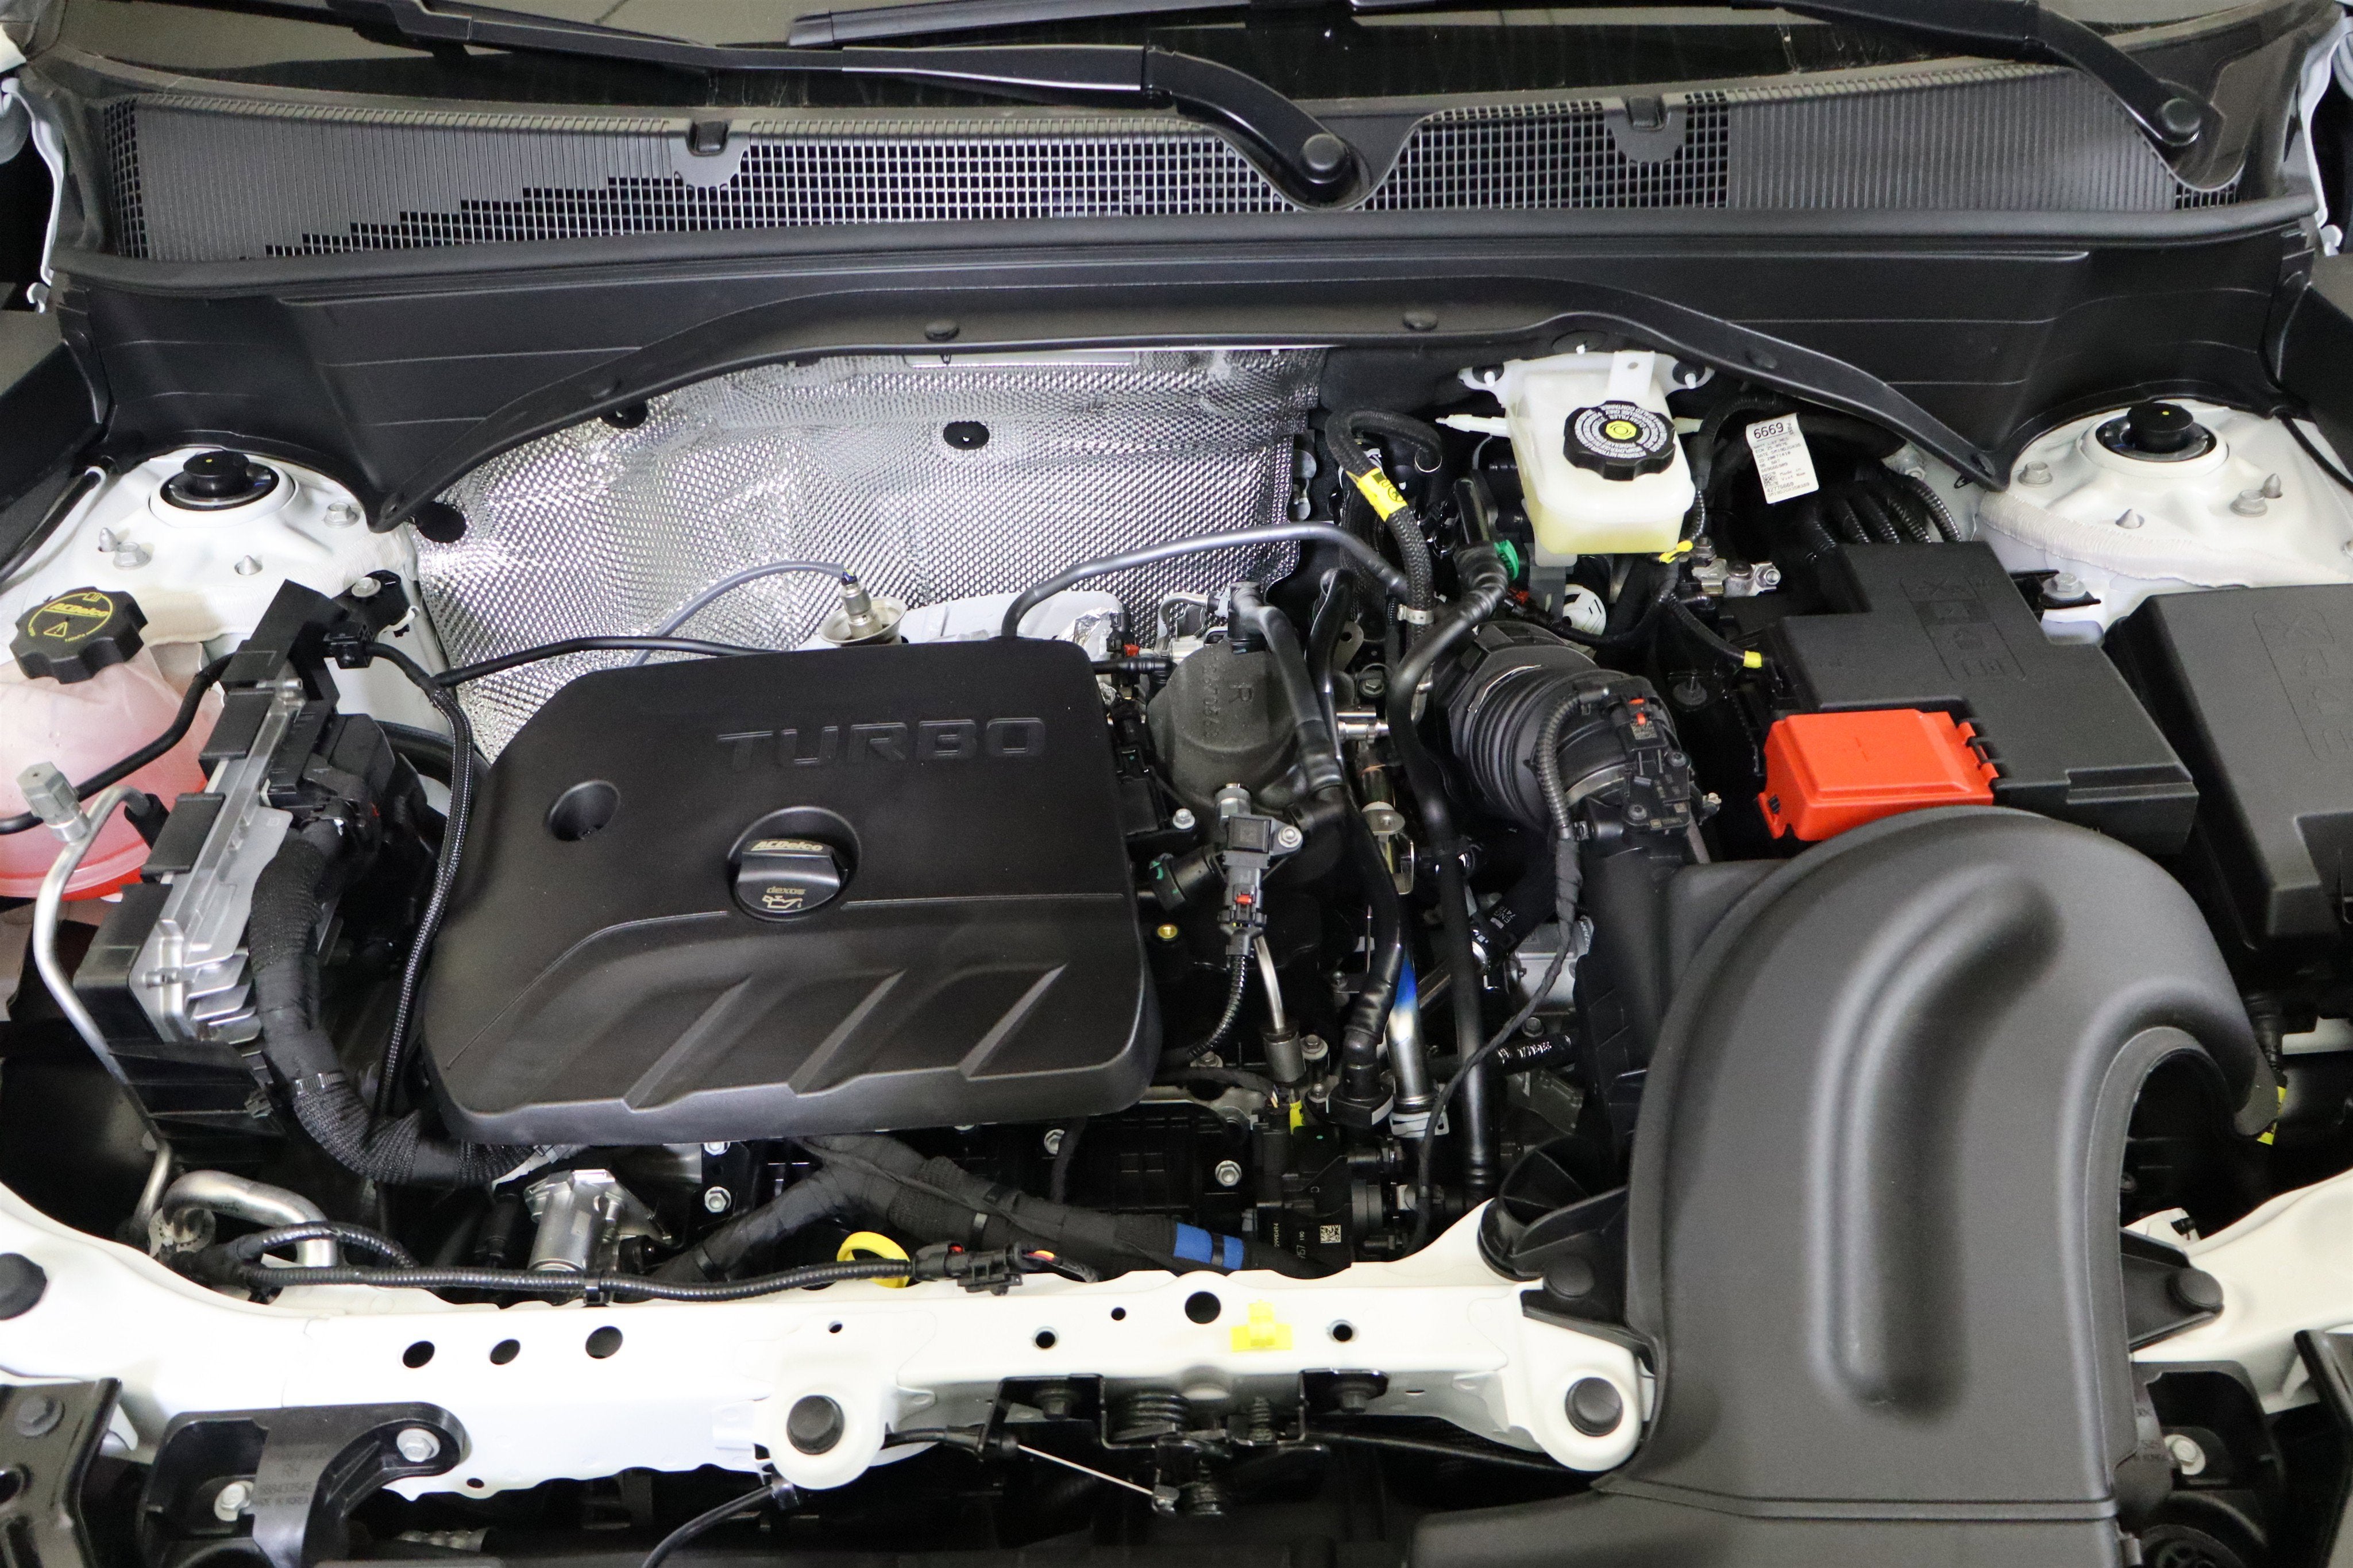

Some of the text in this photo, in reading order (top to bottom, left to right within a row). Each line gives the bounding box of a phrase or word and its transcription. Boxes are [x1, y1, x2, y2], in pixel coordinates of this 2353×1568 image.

[1753, 422, 1784, 439] 6669
[48, 603, 109, 616] ACDelco
[716, 717, 1047, 770] TURBO
[751, 841, 824, 851] ACDelco
[766, 886, 806, 895] dexos
[1494, 910, 1511, 924] ENG
